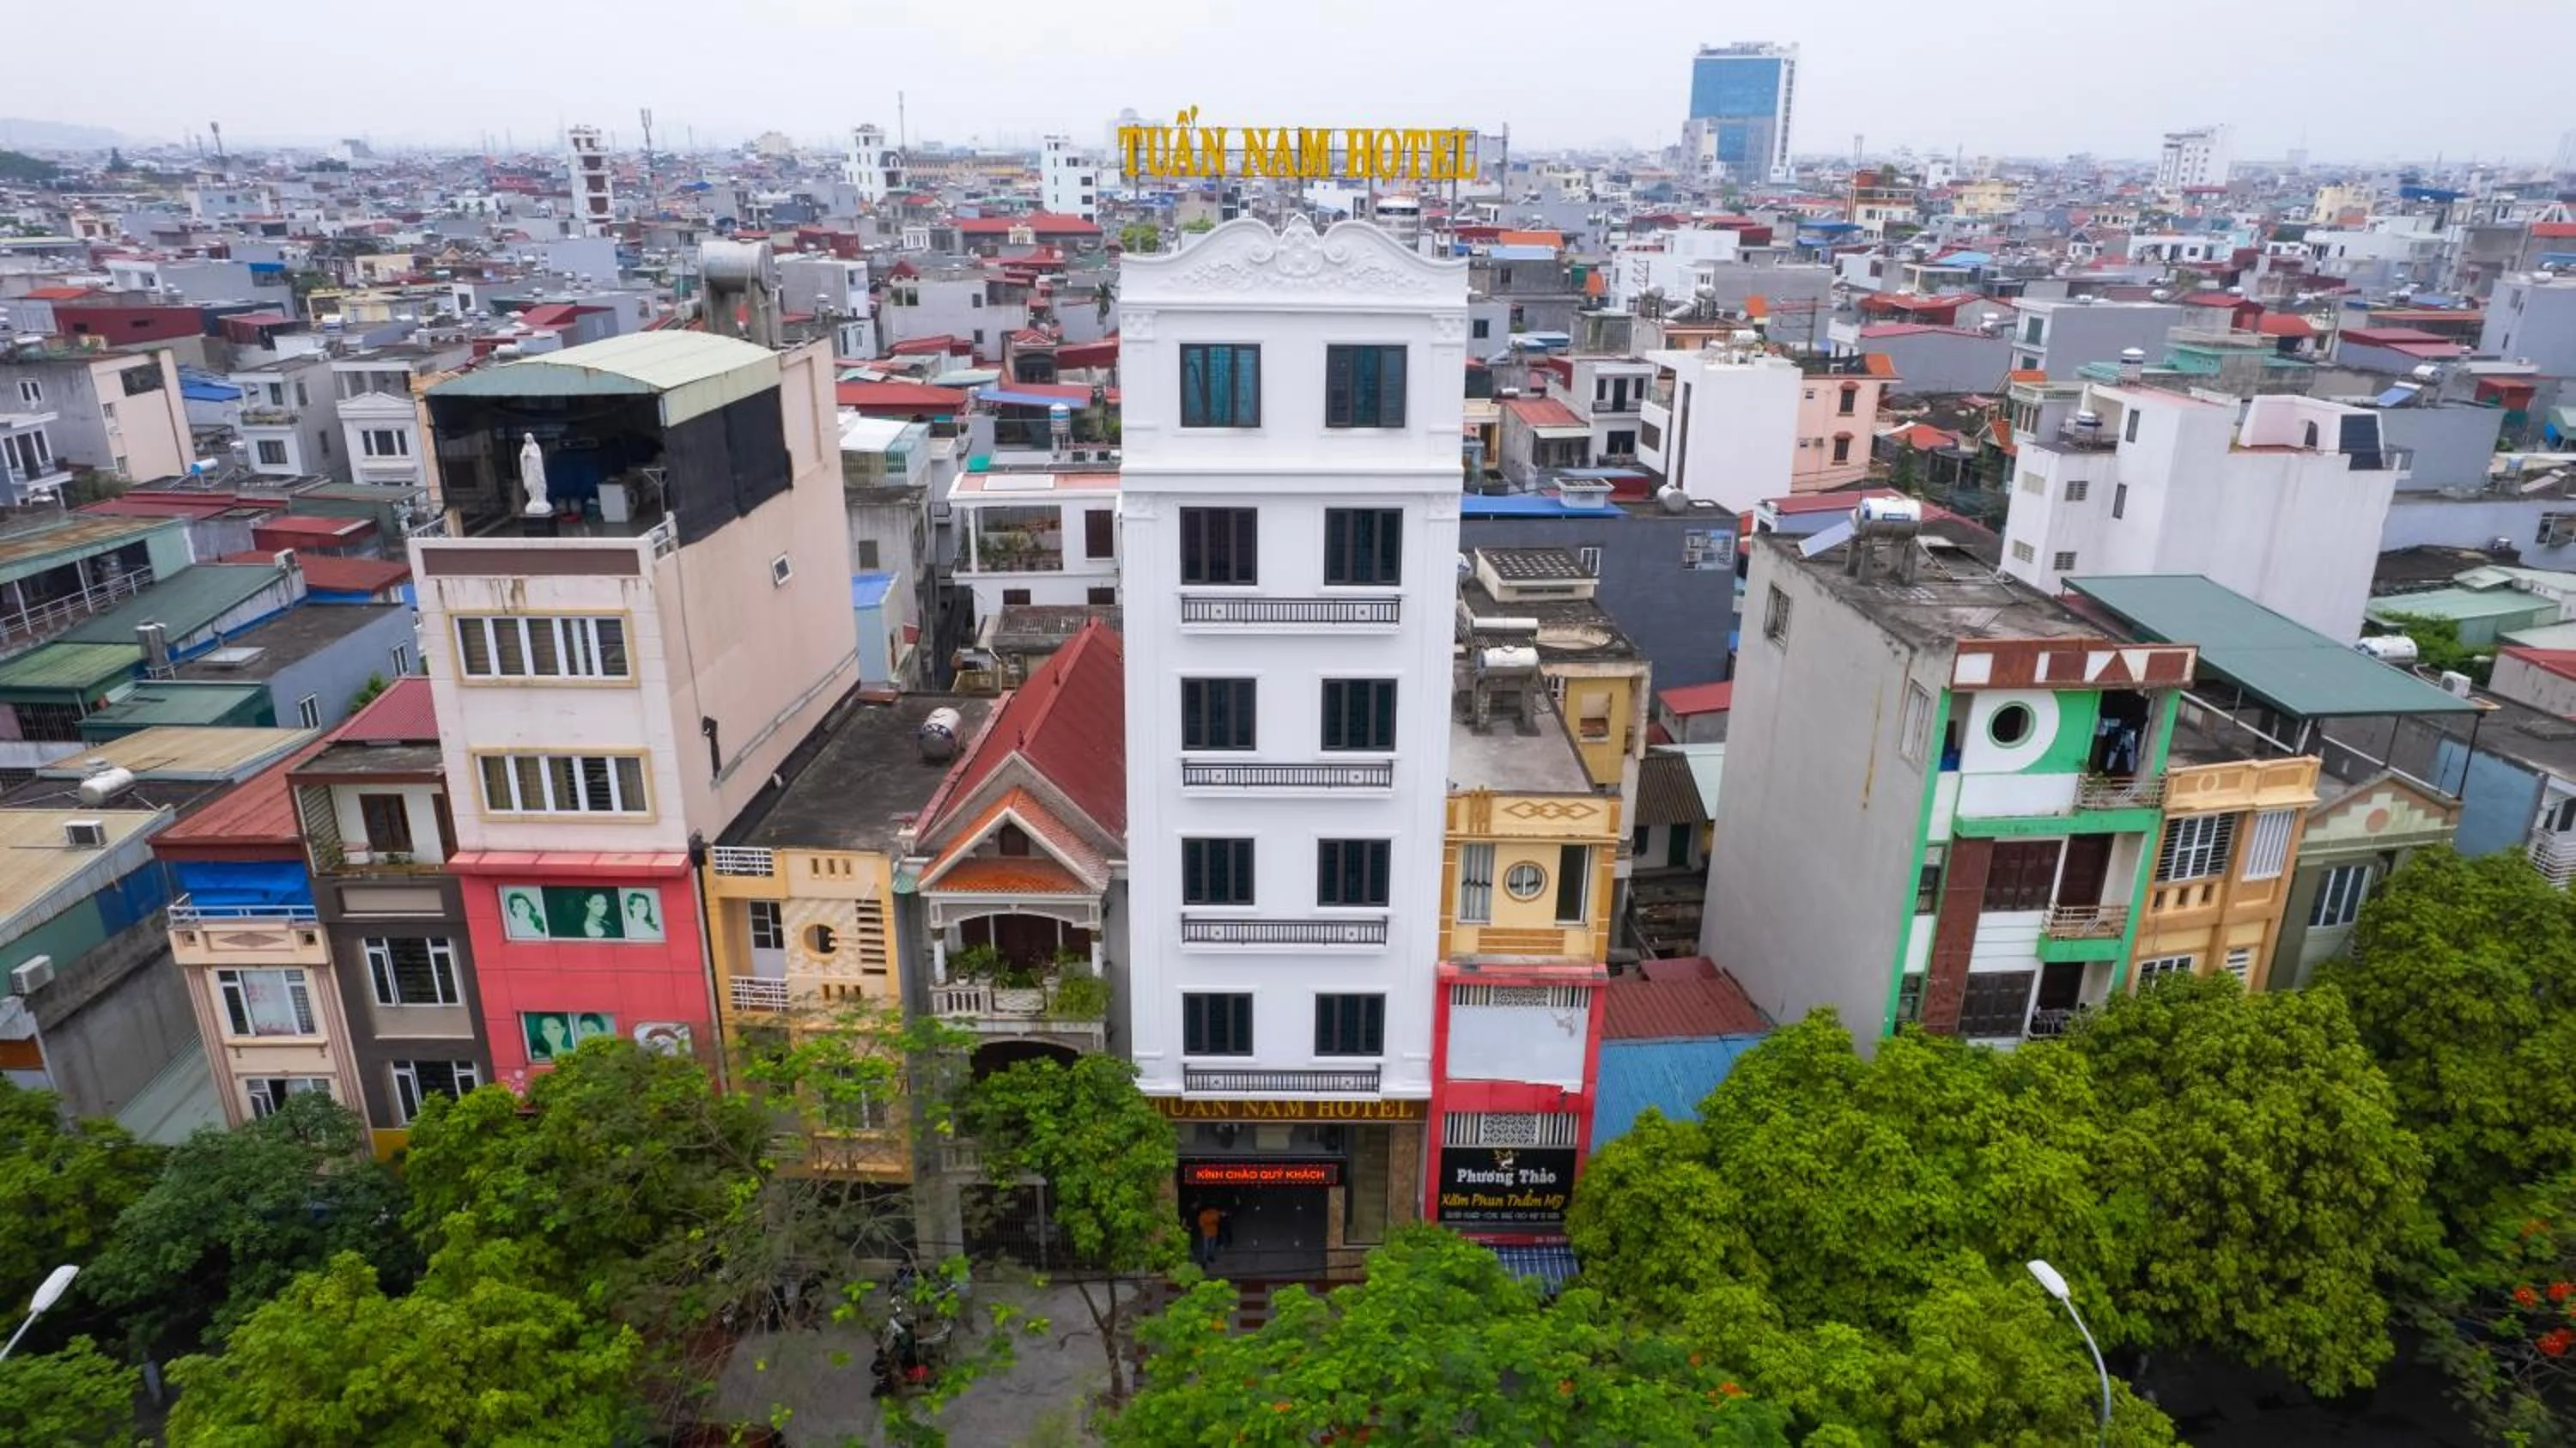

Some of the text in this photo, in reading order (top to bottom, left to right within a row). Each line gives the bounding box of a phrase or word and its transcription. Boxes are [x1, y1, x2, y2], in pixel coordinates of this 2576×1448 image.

[1242, 127, 1330, 178] NAM
[1346, 128, 1478, 179] HOTEL
[1242, 1100, 1304, 1117] NAM
[1317, 1100, 1414, 1119] HOTEL
[1456, 1168, 1514, 1187] Phương
[1472, 1193, 1503, 1207] Phun
